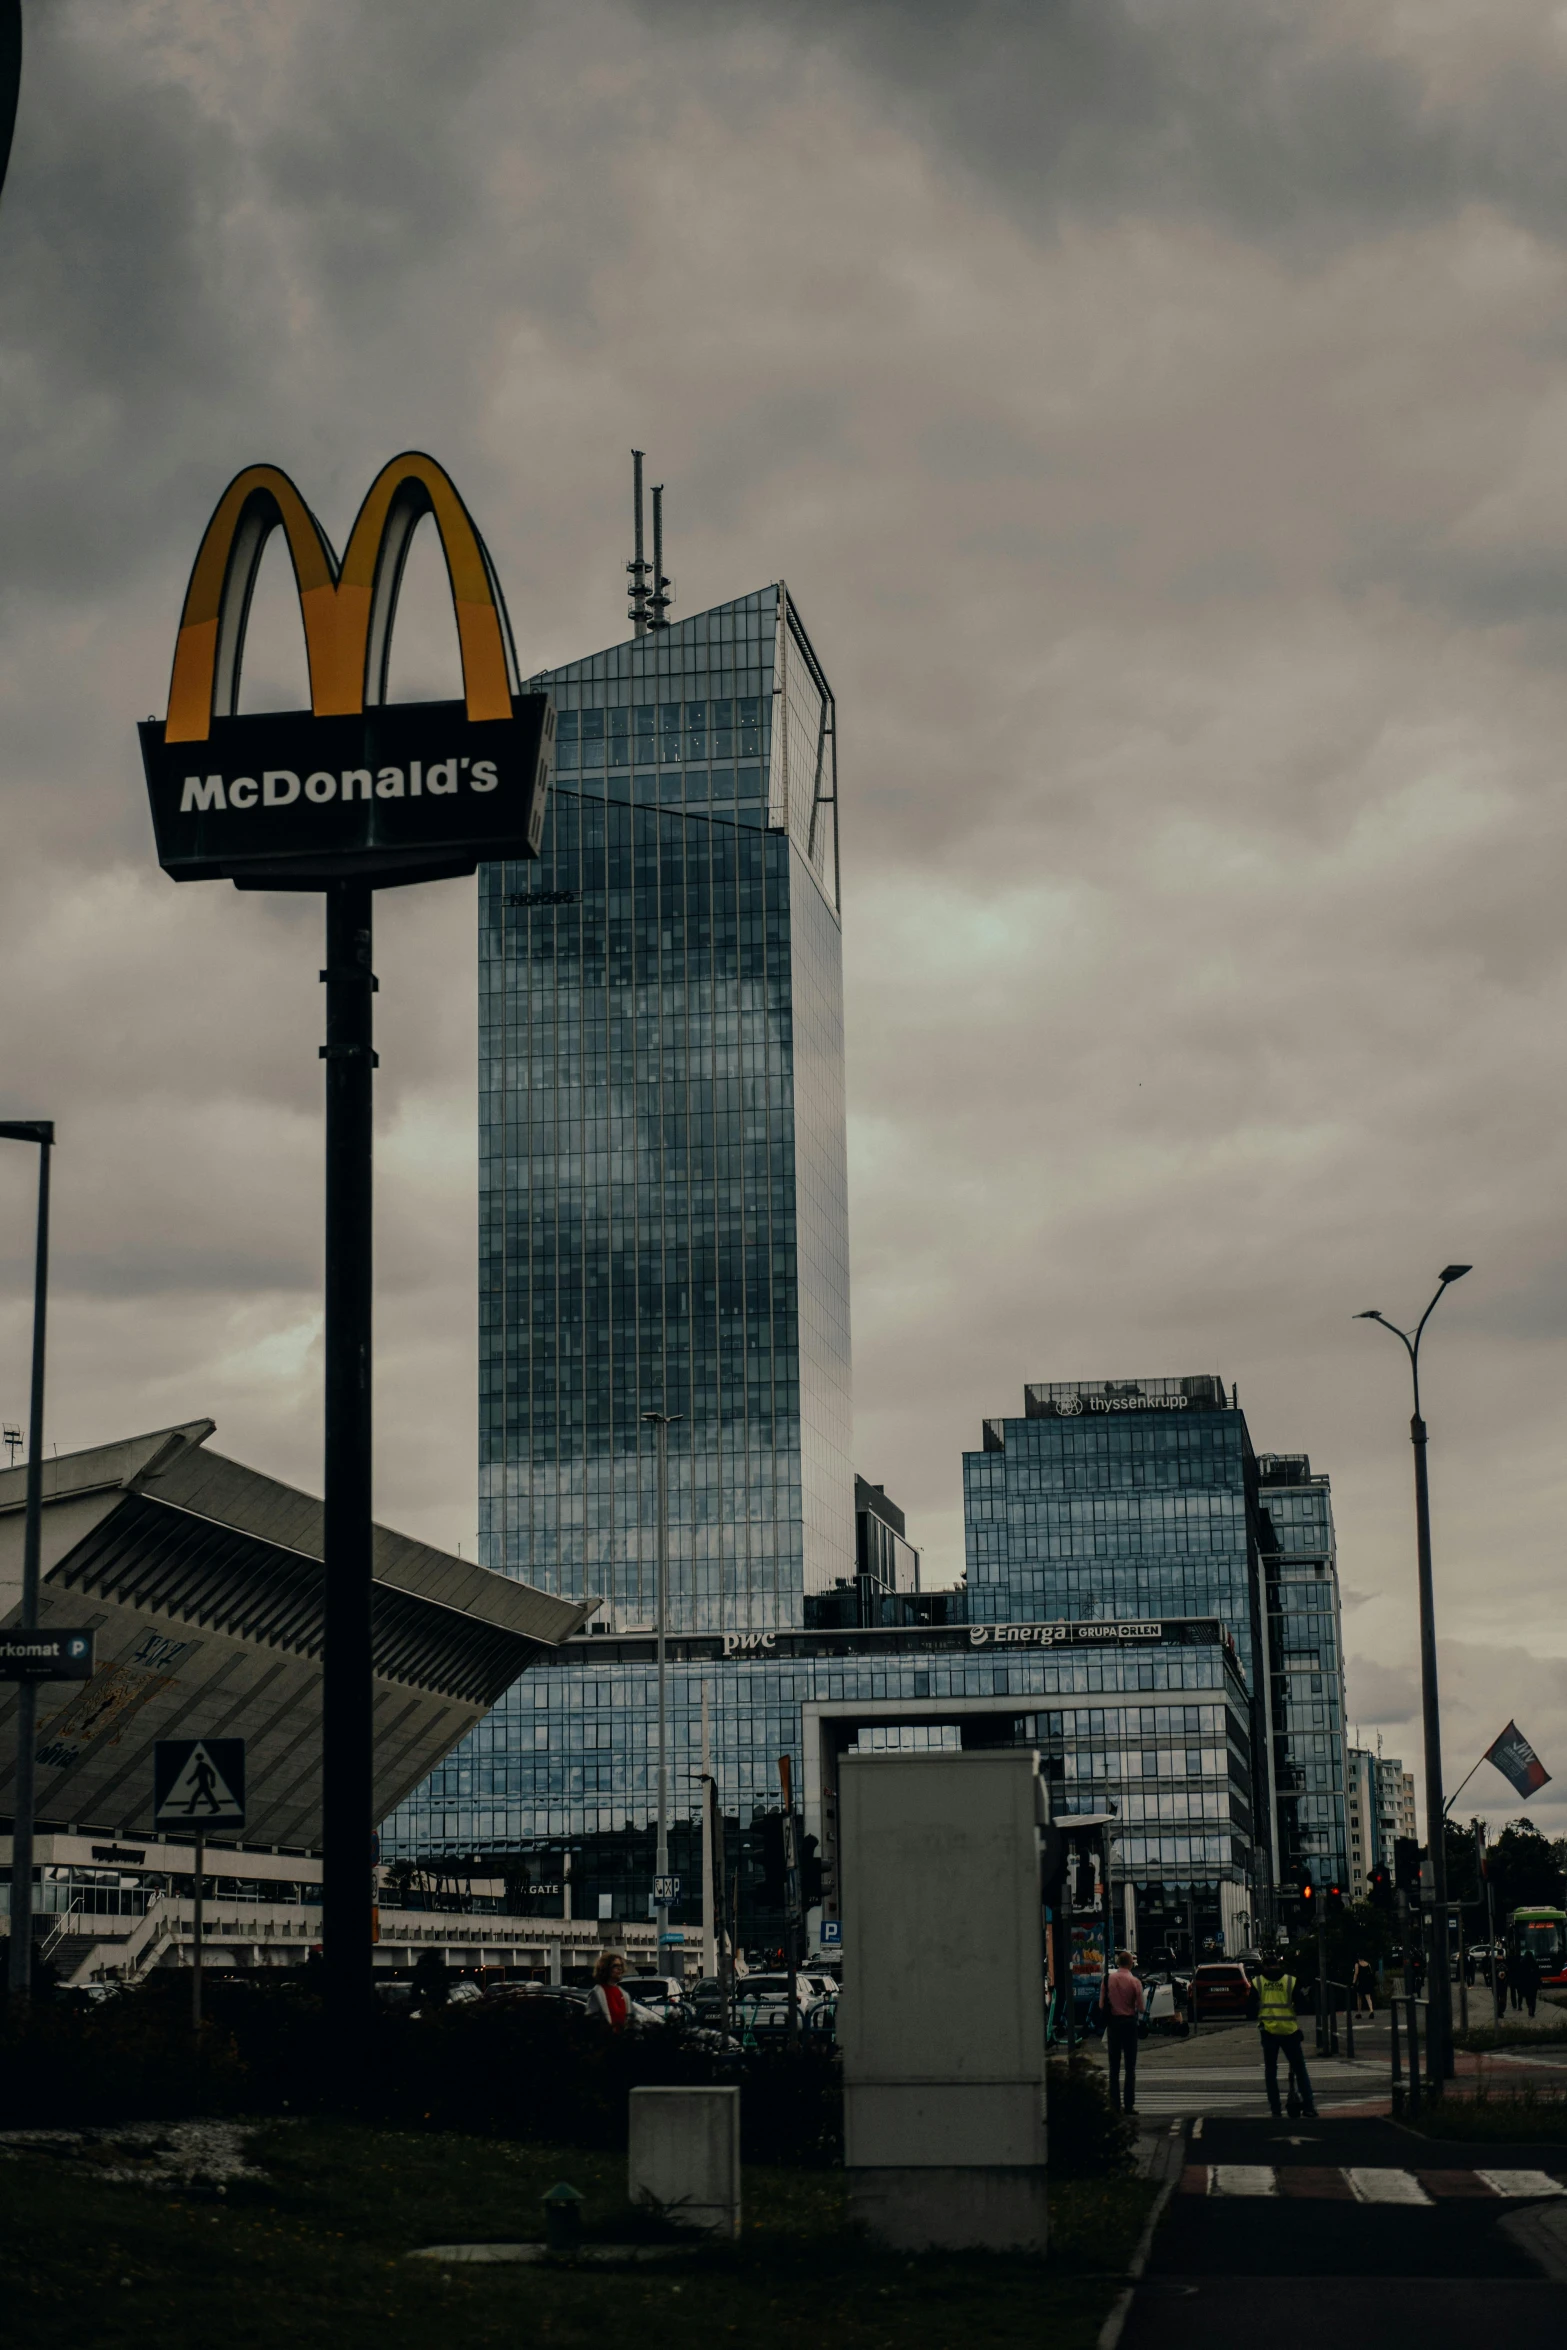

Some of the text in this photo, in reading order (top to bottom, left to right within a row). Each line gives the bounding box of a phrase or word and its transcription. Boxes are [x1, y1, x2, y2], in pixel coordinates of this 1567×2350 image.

[179, 755, 500, 812] McDonald's
[1089, 1395, 1188, 1413] thyssenkrupp
[722, 1632, 776, 1656] pwc
[994, 1625, 1160, 1645] Energa GRUPA ORLEN
[72, 1641, 85, 1656] P
[529, 1885, 559, 1894] GATE
[825, 1923, 838, 1940] P
